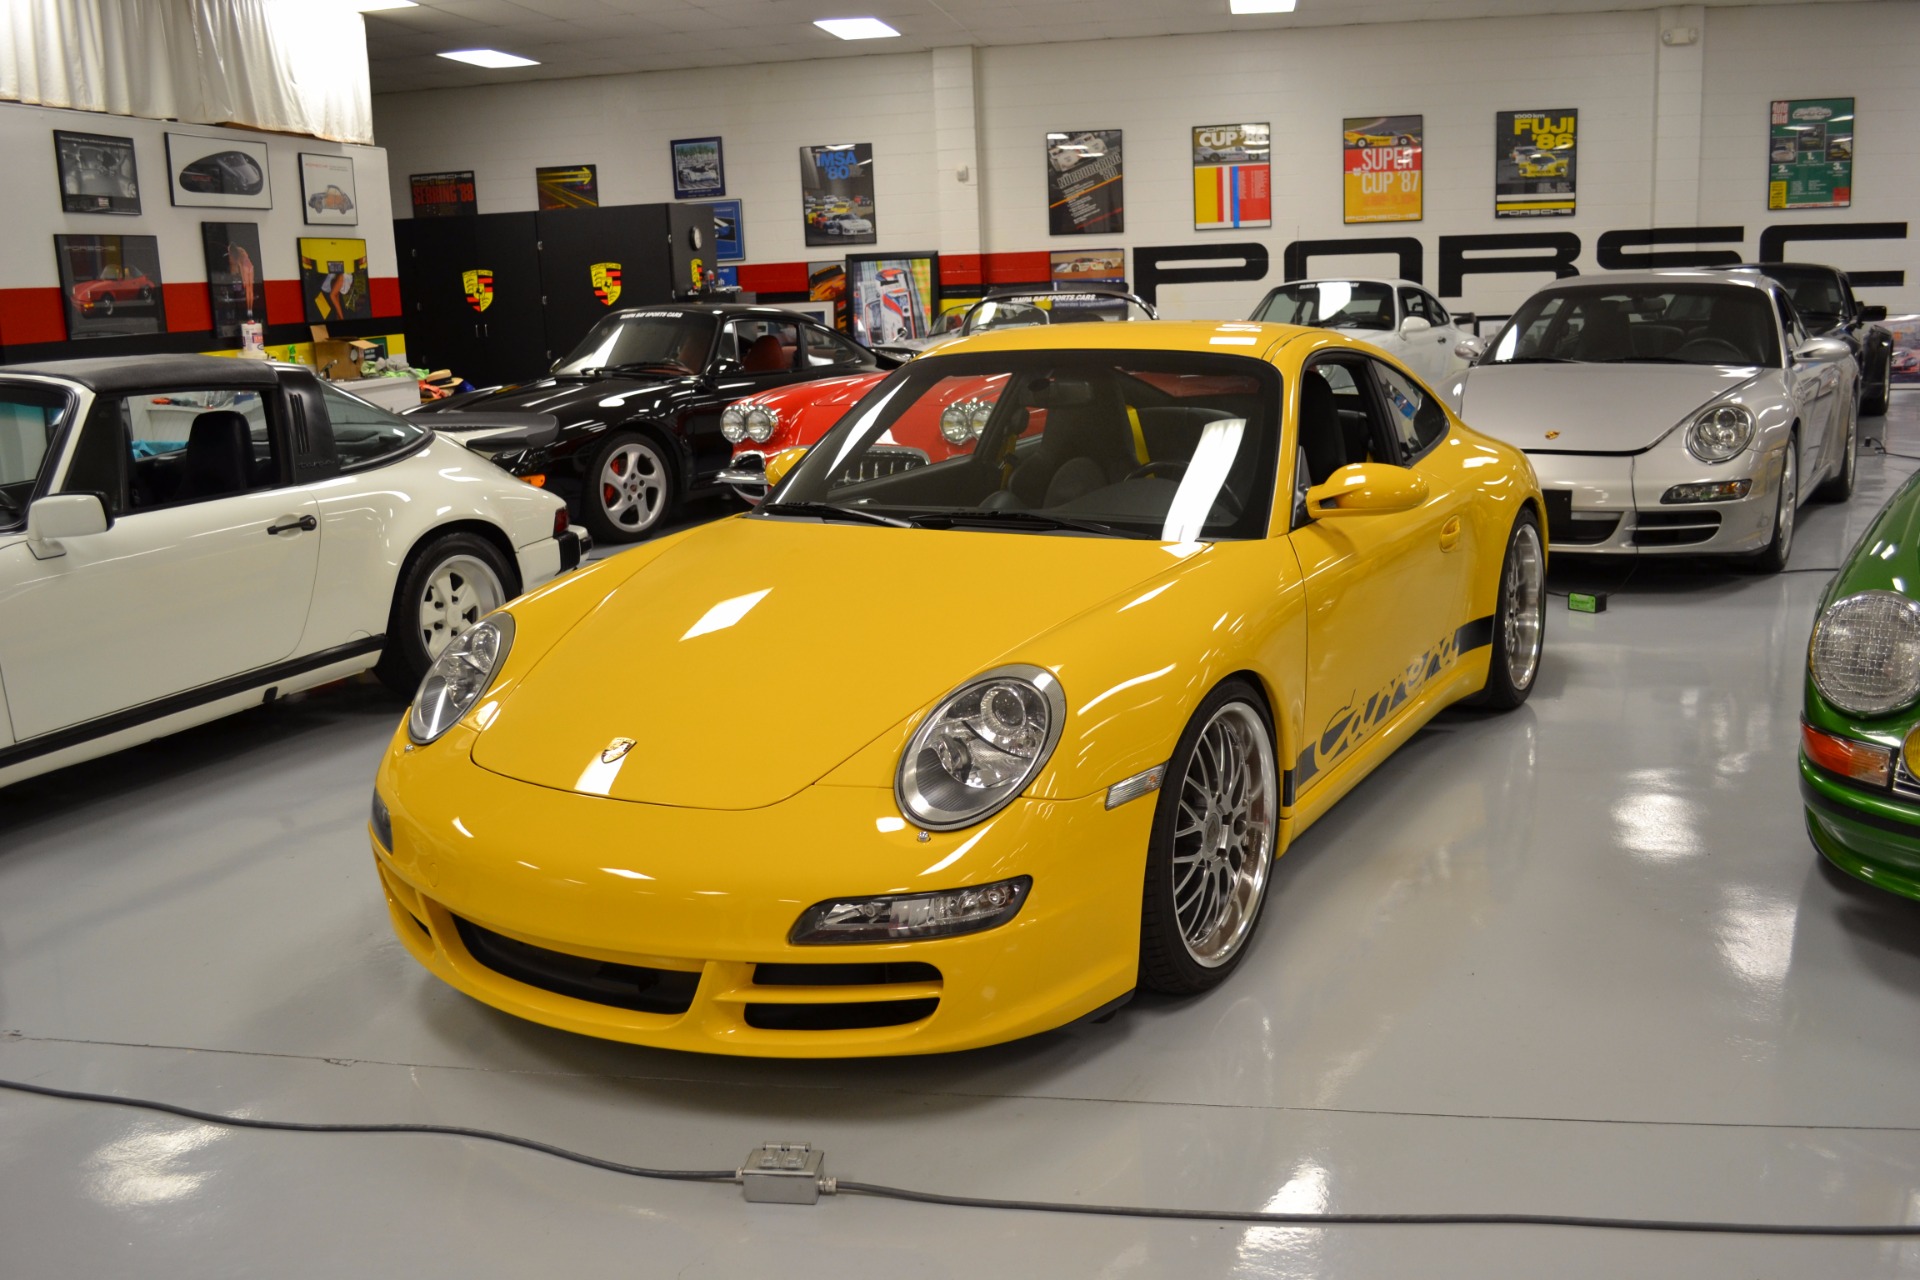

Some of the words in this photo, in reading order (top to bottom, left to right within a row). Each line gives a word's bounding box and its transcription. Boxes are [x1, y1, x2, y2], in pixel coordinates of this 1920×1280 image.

[1514, 117, 1574, 135] FUJI
[1199, 131, 1237, 147] CUP
[1531, 133, 1574, 149] '86
[1362, 146, 1413, 170] SUPER
[411, 173, 472, 181] PORSCHE
[1362, 171, 1394, 194] CUP
[1398, 170, 1419, 192] '87
[413, 185, 457, 205] SEBRING
[1345, 213, 1418, 221] PORSCHE
[1498, 208, 1571, 216] PORSCHE
